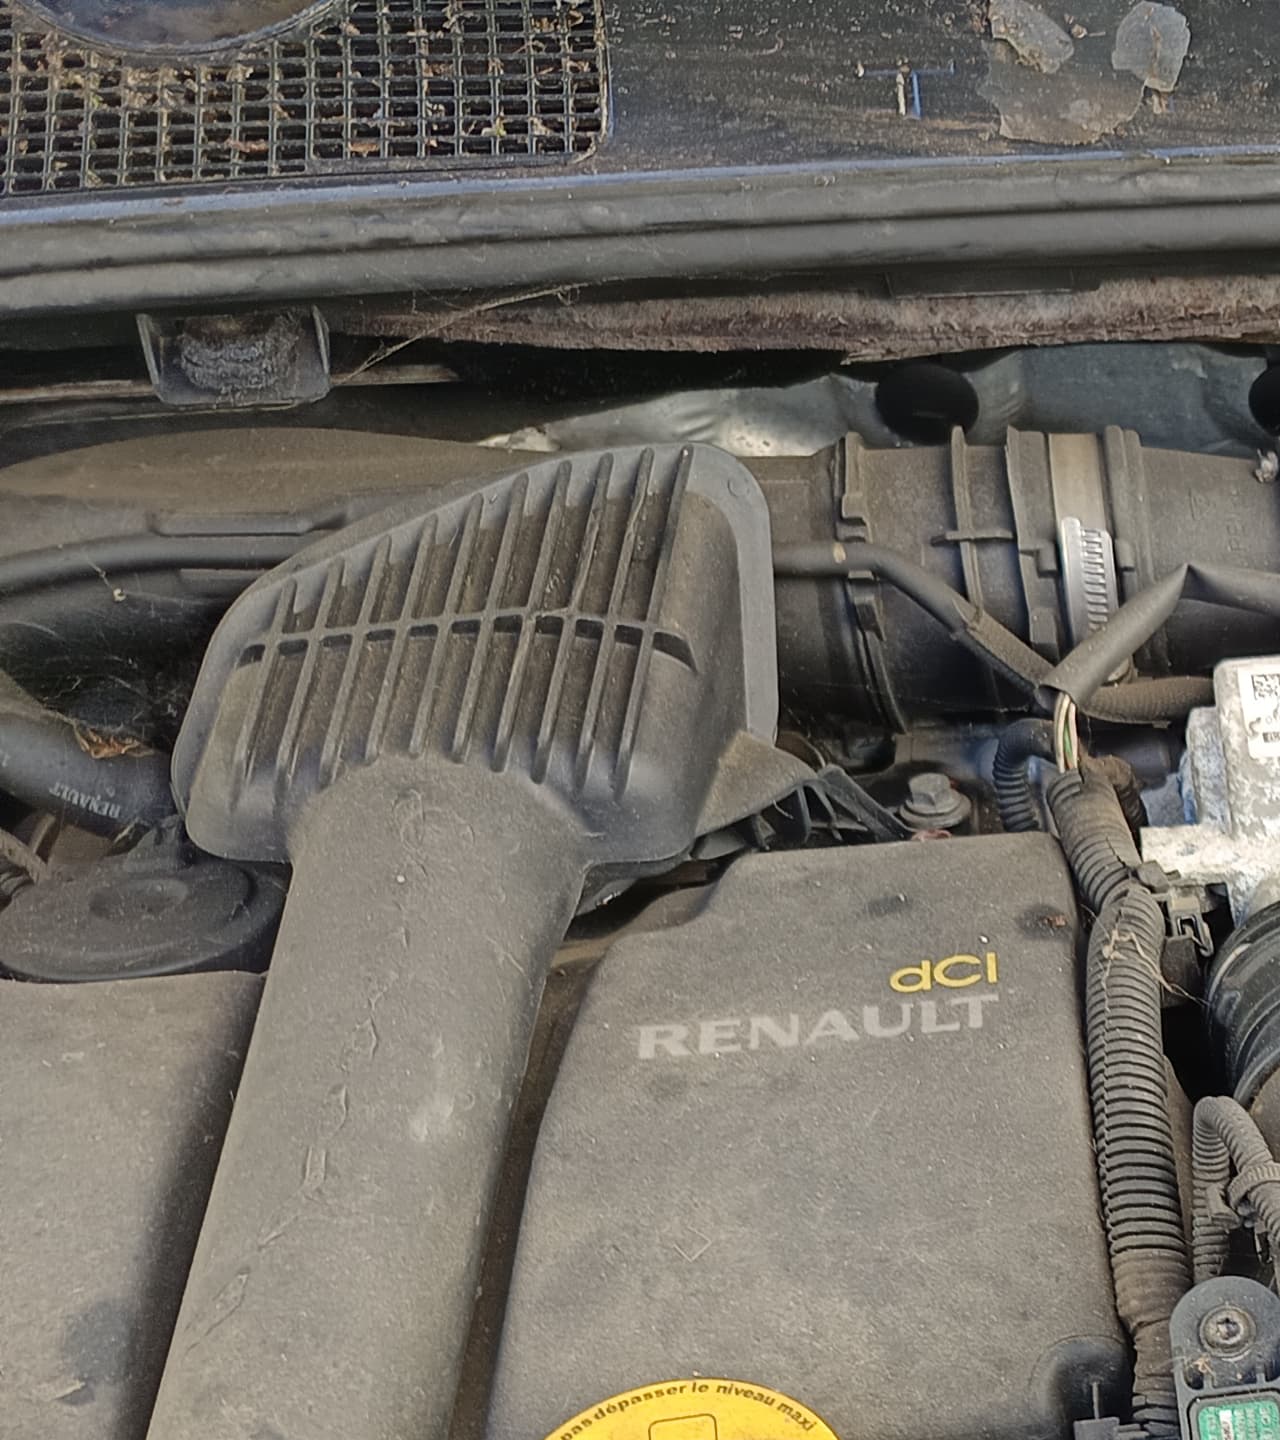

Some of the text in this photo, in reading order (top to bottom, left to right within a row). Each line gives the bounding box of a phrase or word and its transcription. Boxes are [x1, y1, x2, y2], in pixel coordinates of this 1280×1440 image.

[48, 782, 121, 819] RENAULT
[637, 994, 999, 1059] RENAULT
[593, 1384, 688, 1421] dépasser
[691, 1381, 709, 1394] le
[716, 1382, 776, 1407] niveau
[777, 1398, 818, 1433] maxi
